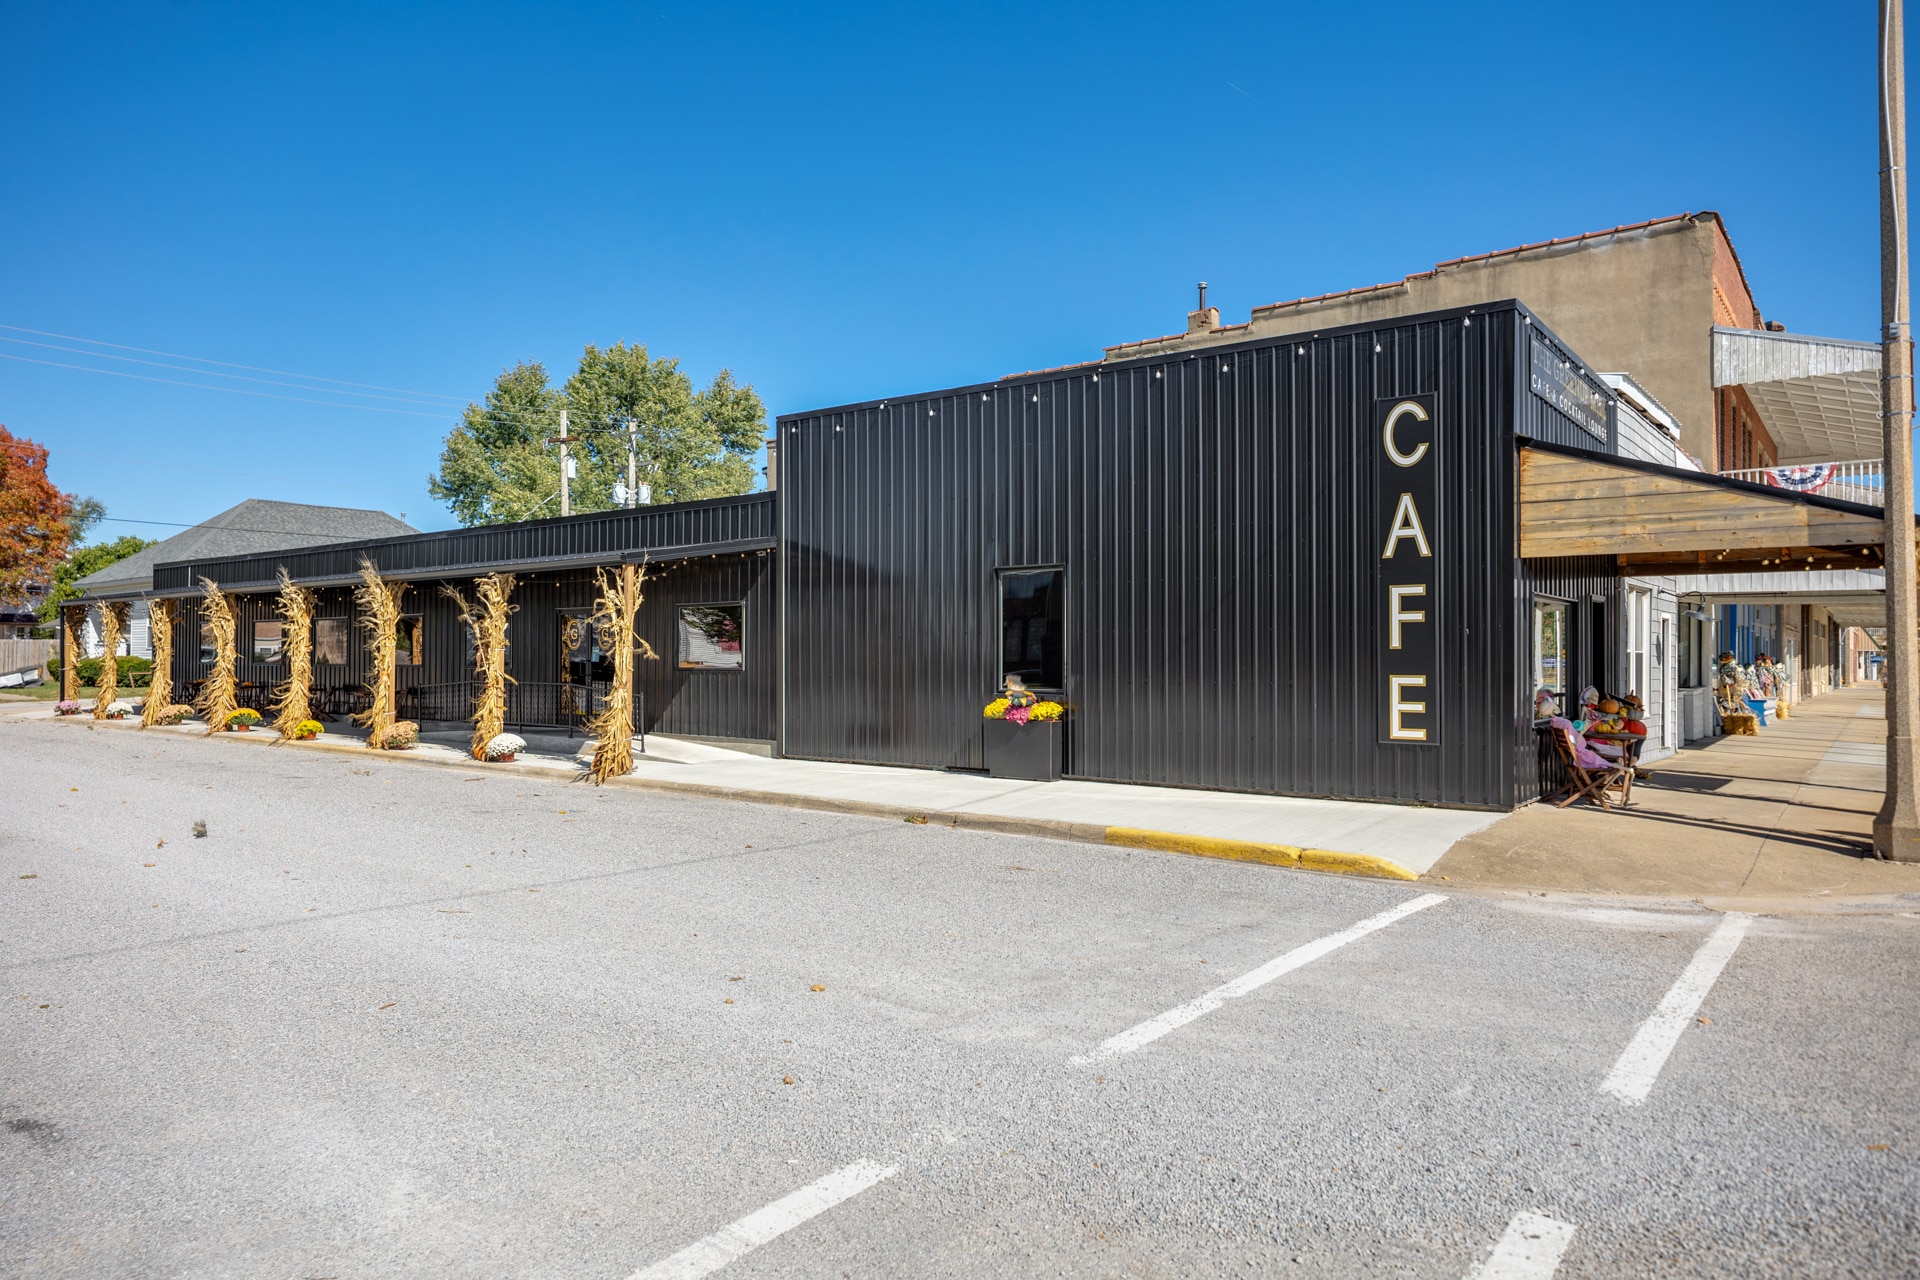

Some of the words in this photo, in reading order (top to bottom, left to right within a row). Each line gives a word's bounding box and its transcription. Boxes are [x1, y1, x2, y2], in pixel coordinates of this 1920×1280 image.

[1532, 340, 1551, 375] THE
[1532, 373, 1549, 398] CAFE
[1559, 394, 1587, 426] COCKTAIL
[1382, 400, 1432, 741] CAFE
